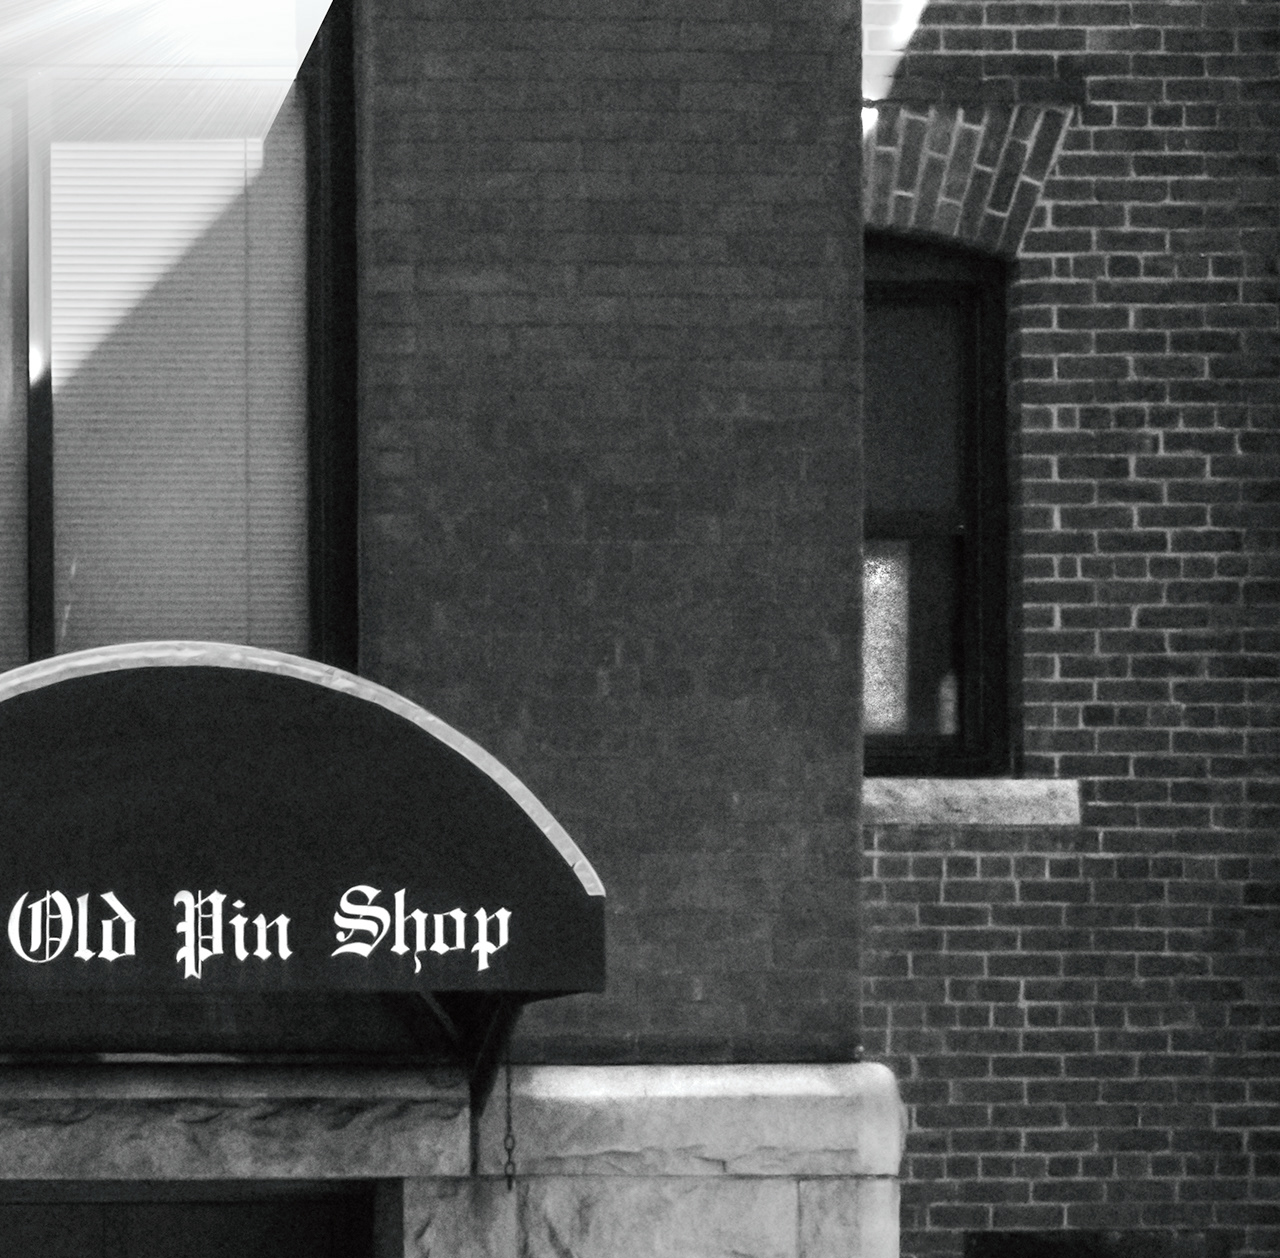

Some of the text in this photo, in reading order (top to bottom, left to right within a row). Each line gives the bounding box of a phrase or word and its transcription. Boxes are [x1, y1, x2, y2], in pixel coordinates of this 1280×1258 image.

[7, 889, 137, 963] Old
[173, 889, 294, 980] Pin
[331, 884, 513, 974] Shop
